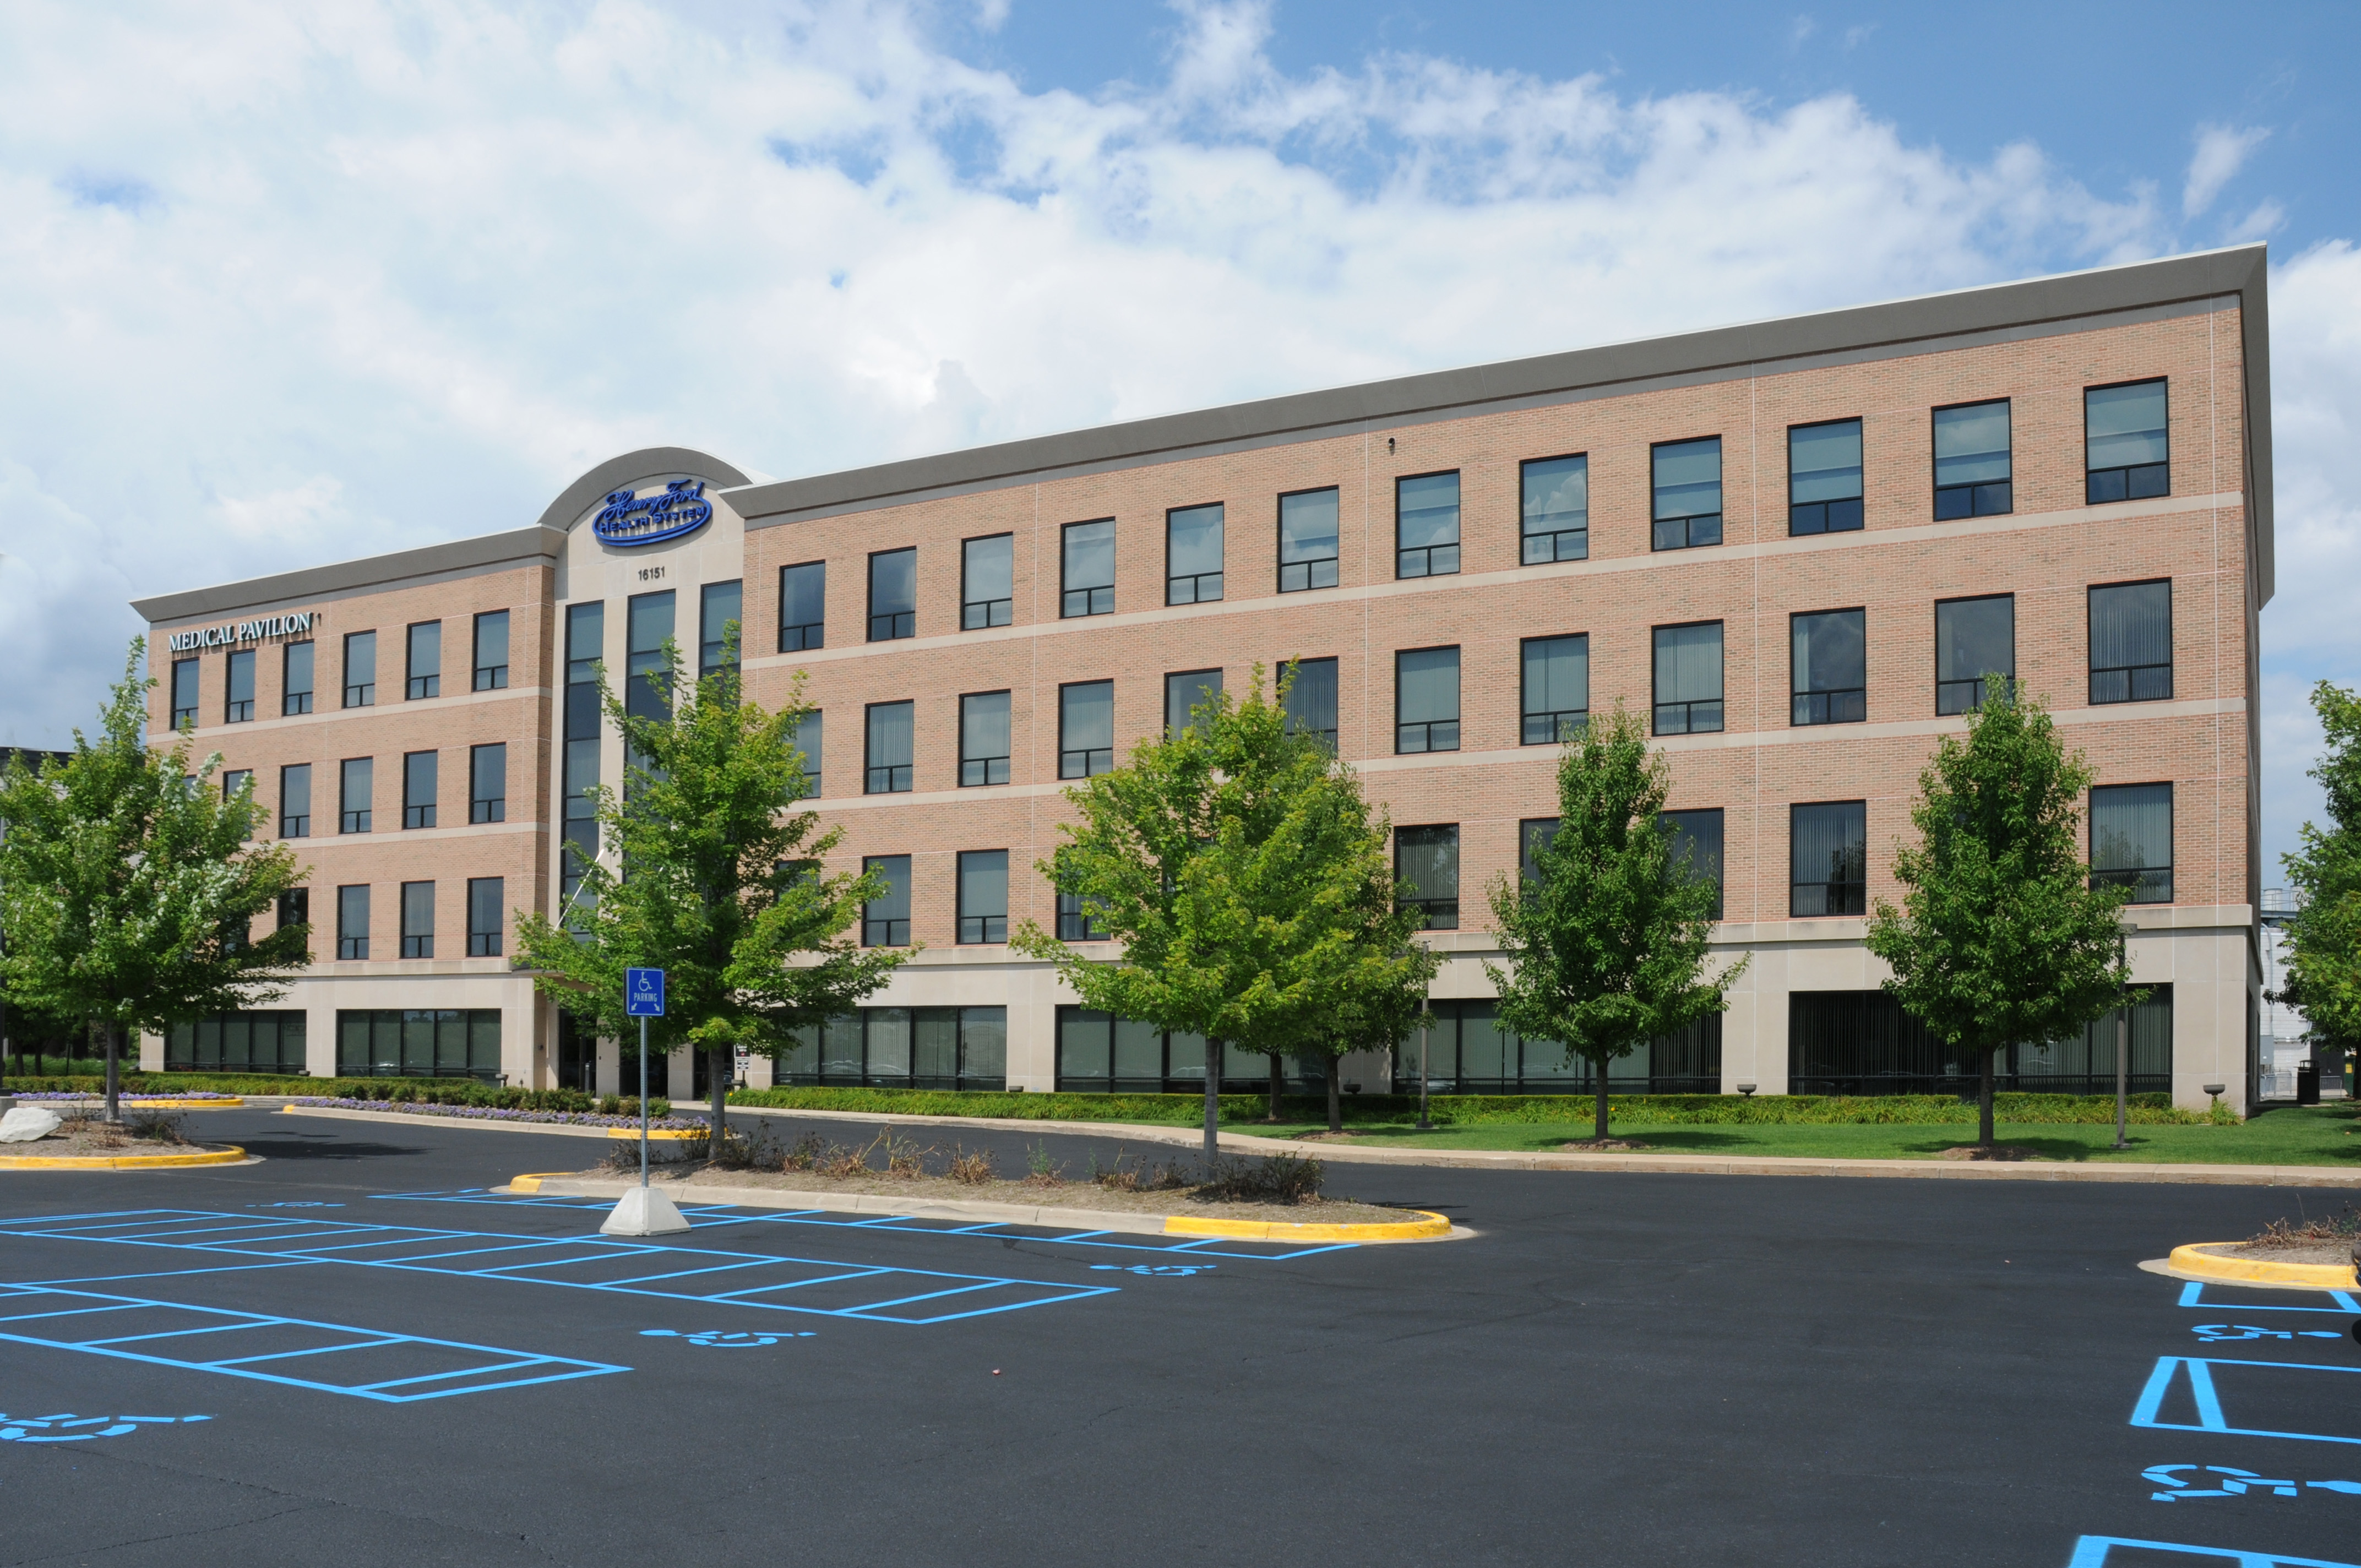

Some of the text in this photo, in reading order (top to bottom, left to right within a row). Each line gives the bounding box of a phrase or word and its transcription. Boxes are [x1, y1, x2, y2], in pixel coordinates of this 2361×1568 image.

[603, 479, 705, 520] Henry Ford
[599, 506, 706, 532] HEALTH SYSTEM
[638, 565, 665, 582] 16151
[168, 612, 313, 652] MEDICAL PAVILION
[634, 992, 657, 1002] PARKING
